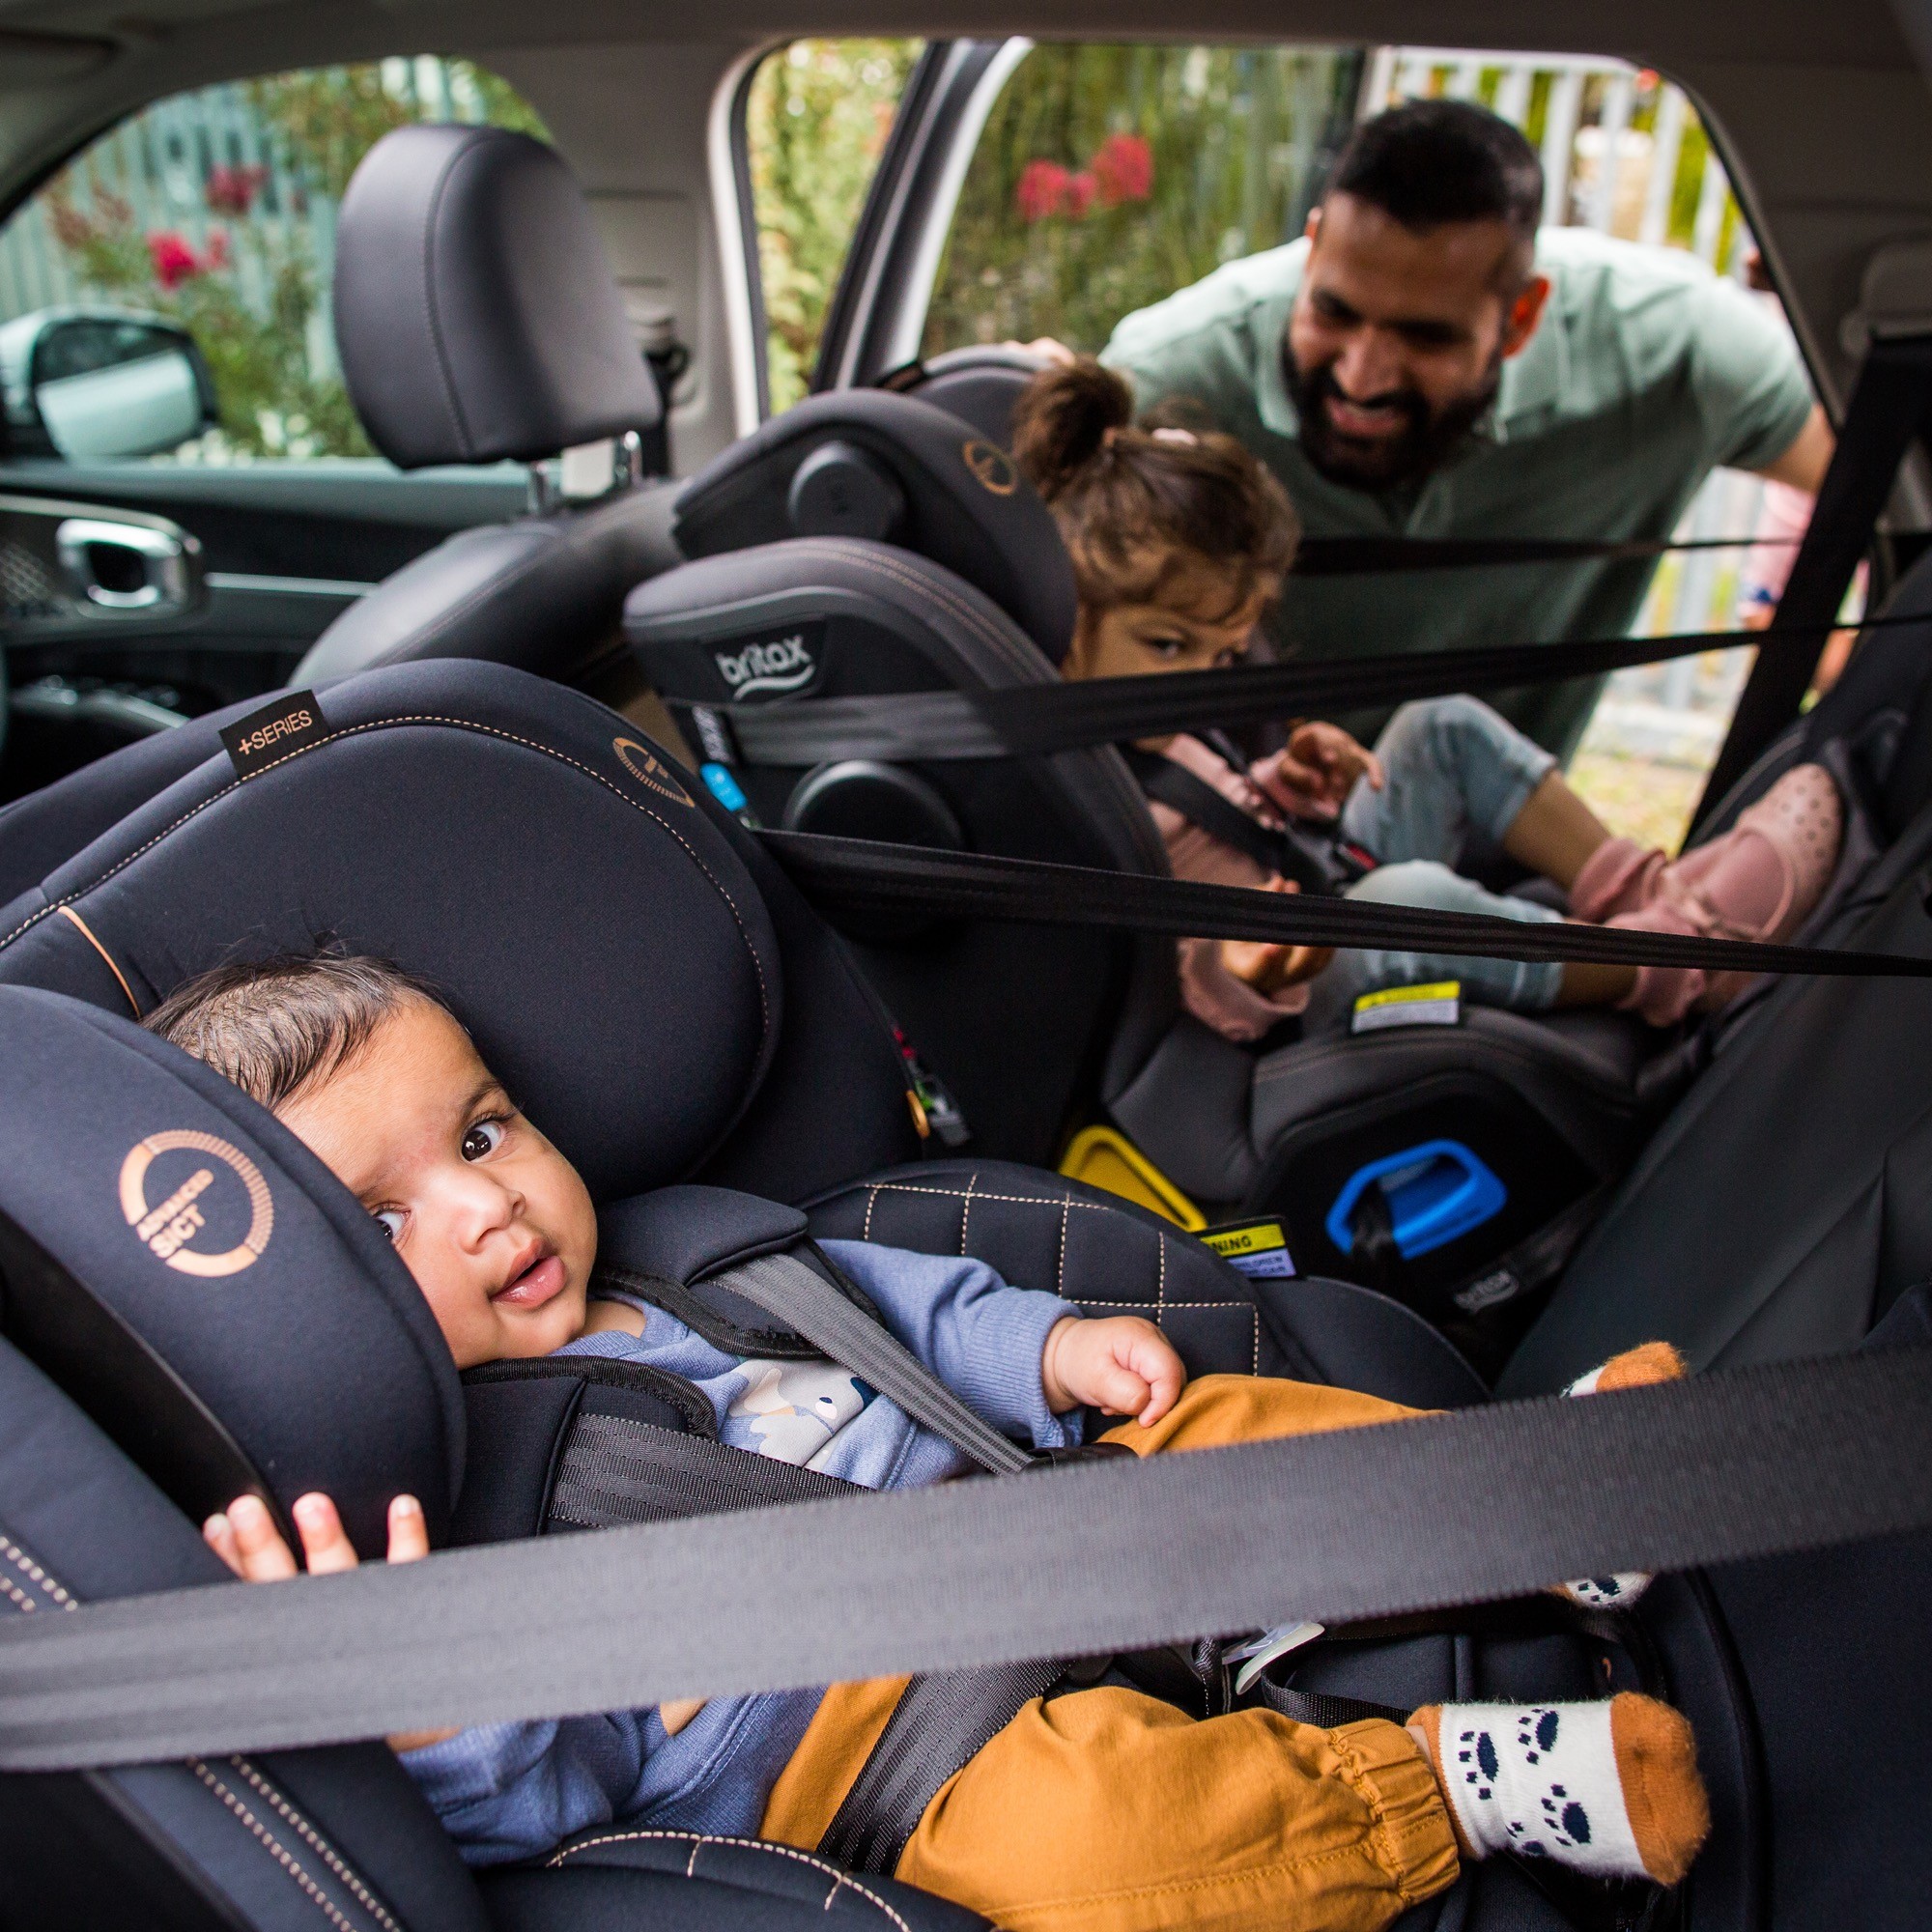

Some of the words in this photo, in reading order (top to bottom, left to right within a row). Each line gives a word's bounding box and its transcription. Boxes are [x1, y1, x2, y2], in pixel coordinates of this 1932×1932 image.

[715, 634, 812, 686] britax
[238, 709, 313, 755] +SERIES
[149, 1204, 206, 1259] SICT
[1211, 1235, 1253, 1253] NING
